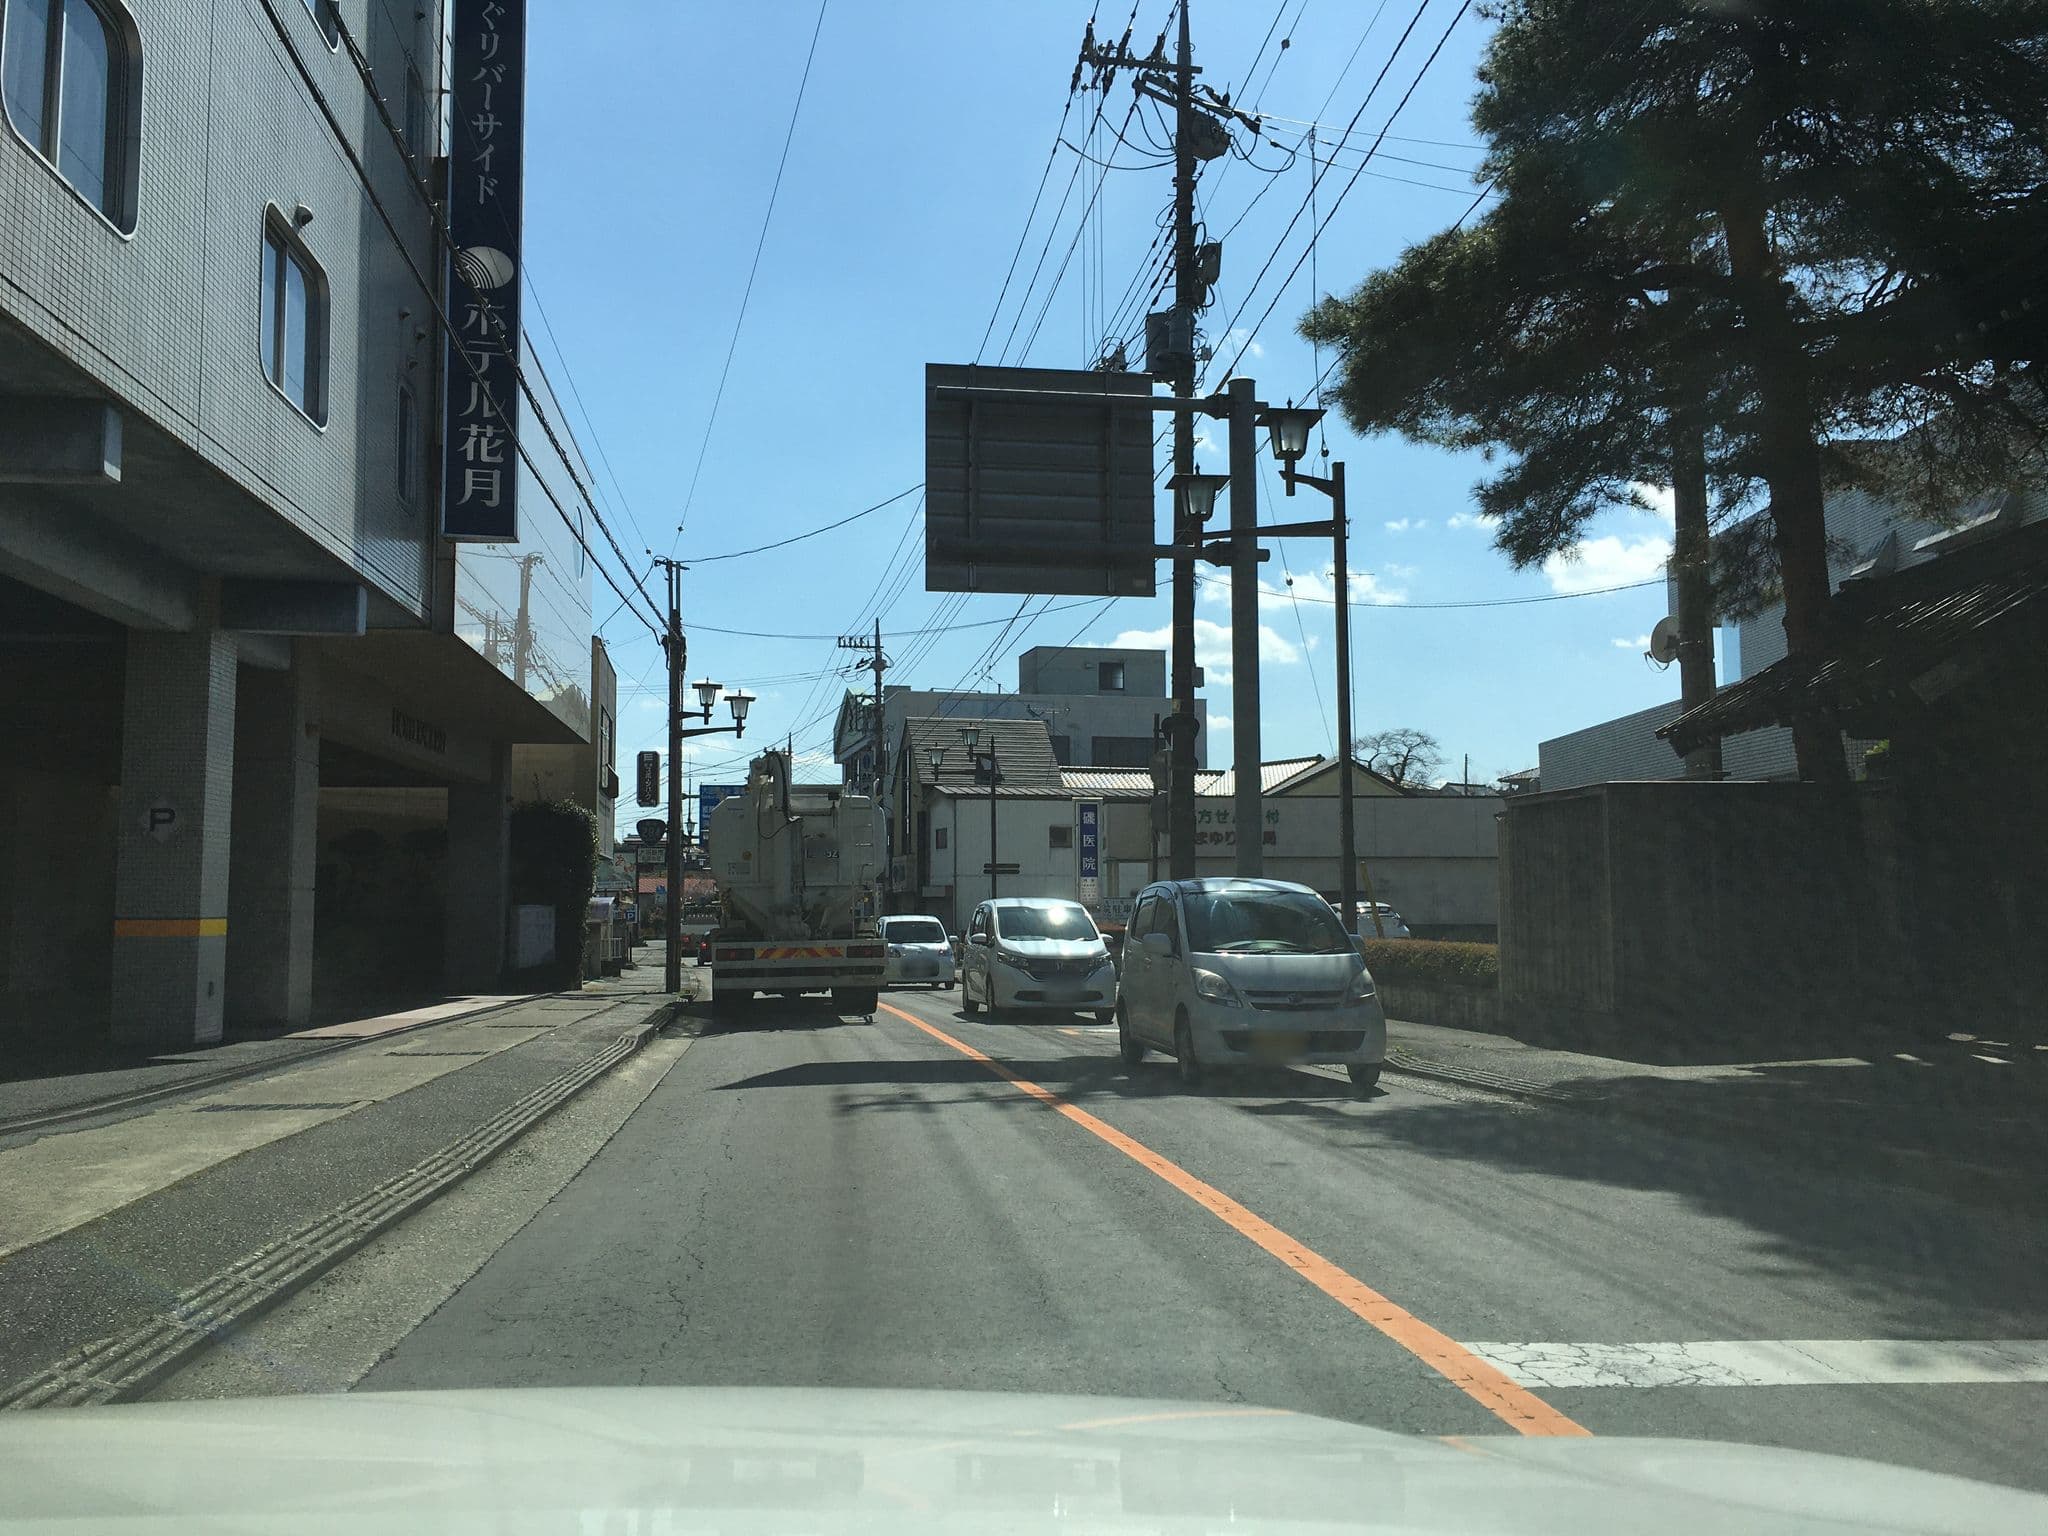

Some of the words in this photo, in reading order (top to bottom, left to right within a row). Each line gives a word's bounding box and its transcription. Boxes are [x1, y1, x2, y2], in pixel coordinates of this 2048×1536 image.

[471, 1, 506, 205] ぐリバーサイド
[456, 299, 509, 508] ホテル花月
[149, 807, 176, 832] P
[1082, 811, 1096, 871] 磯医院
